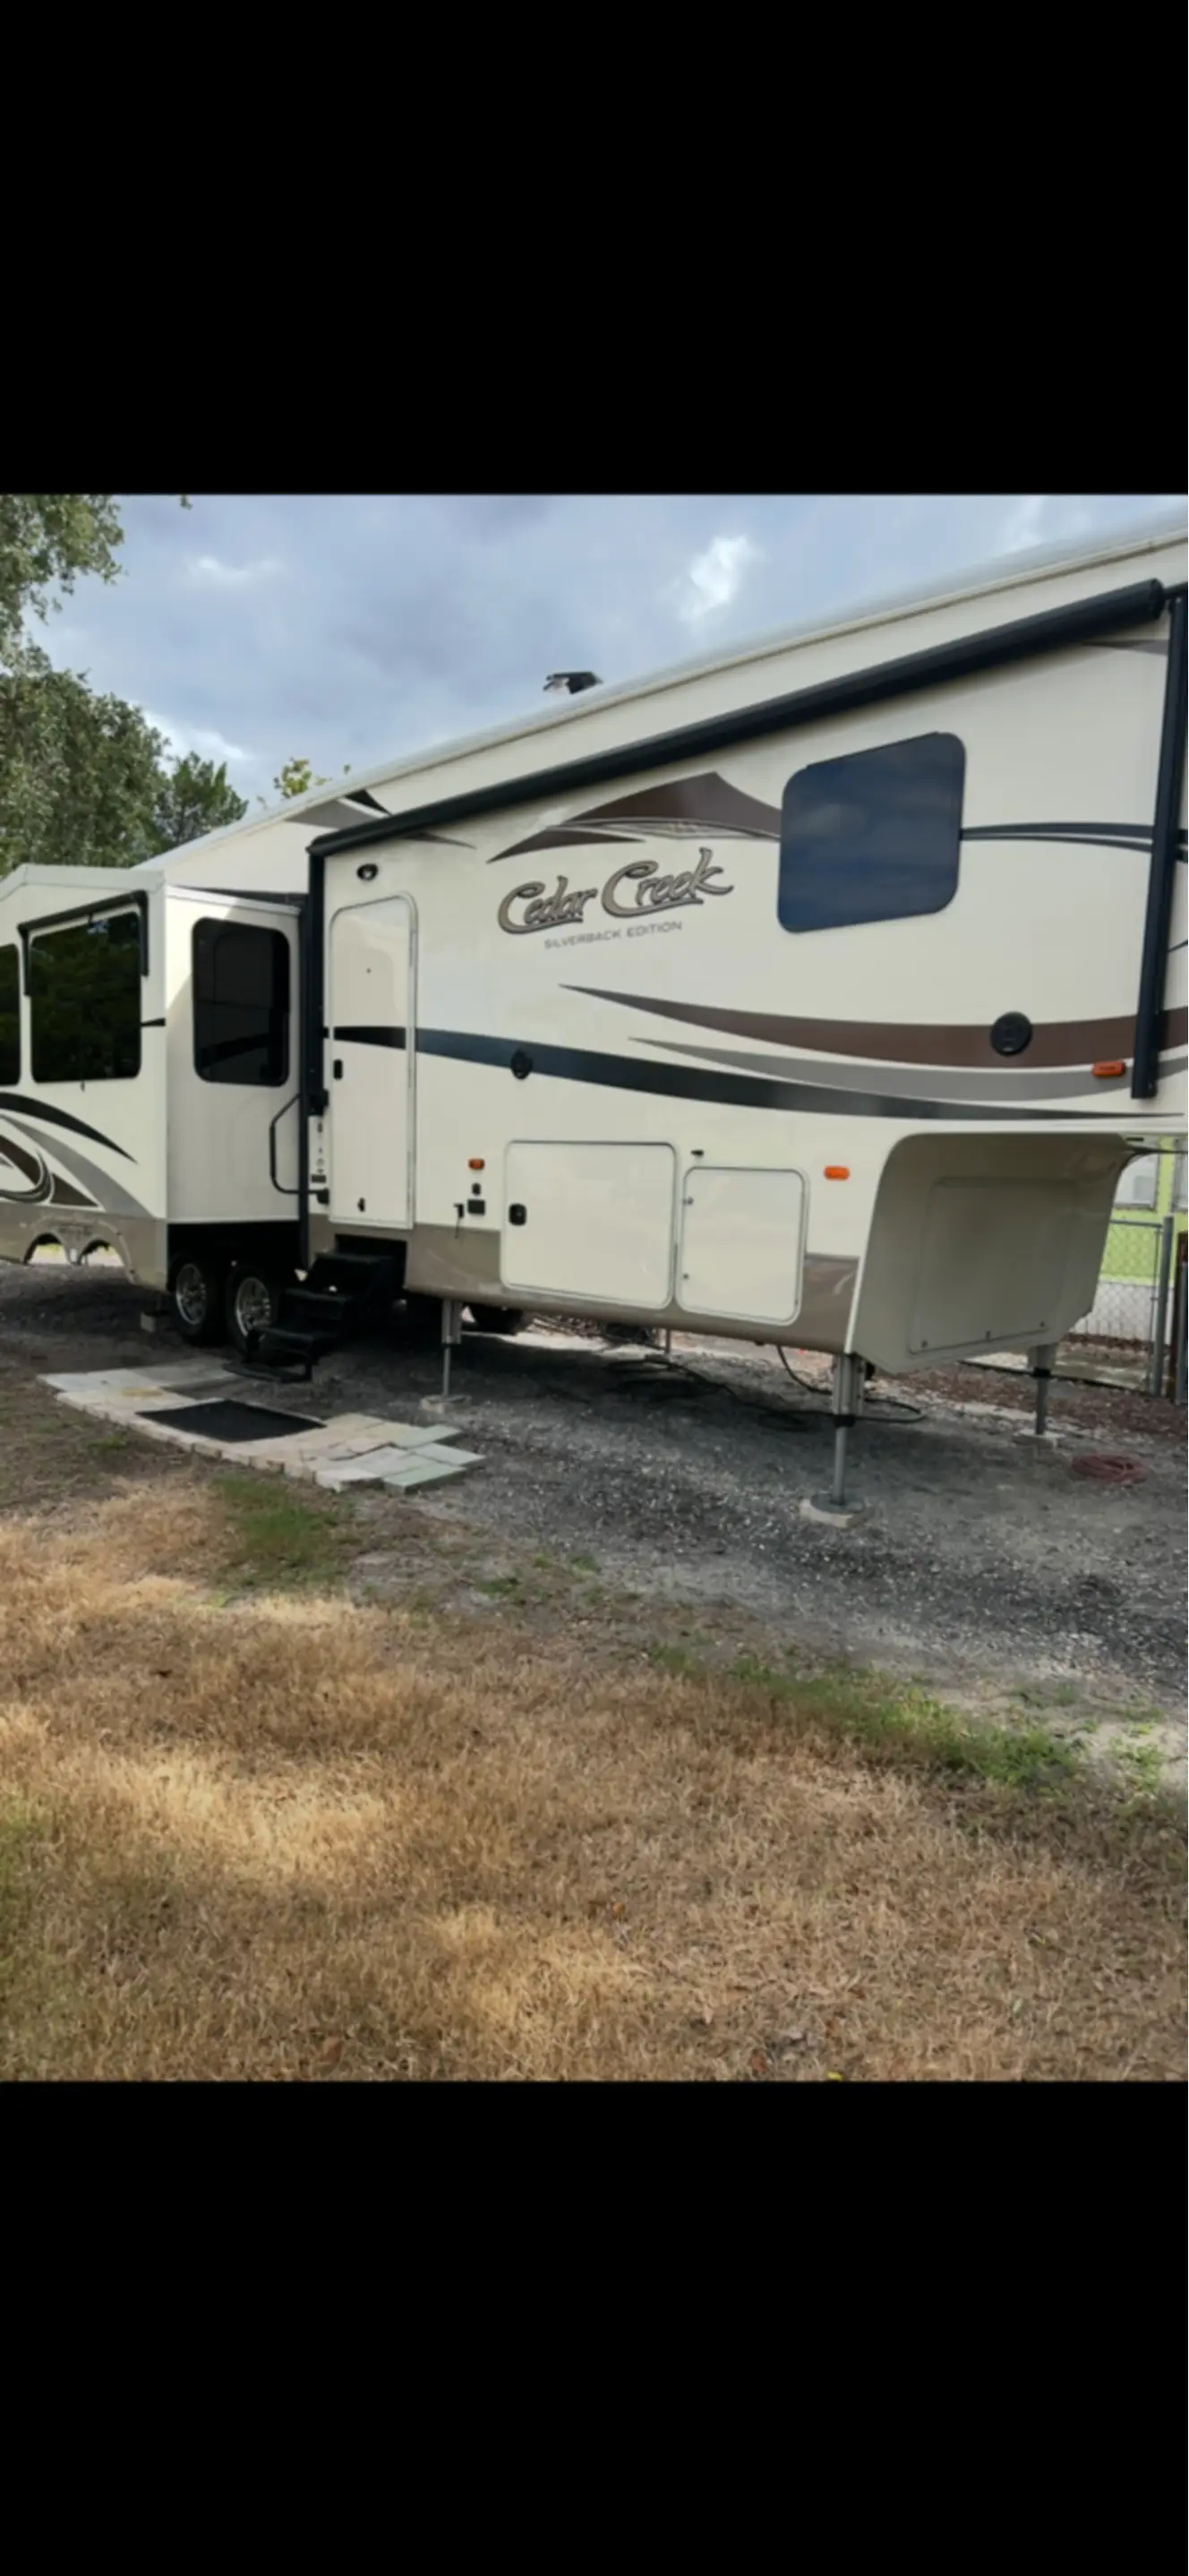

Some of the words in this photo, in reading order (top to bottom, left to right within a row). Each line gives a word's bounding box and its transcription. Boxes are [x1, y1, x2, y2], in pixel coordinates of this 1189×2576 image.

[498, 875, 598, 934] Cedar
[602, 847, 734, 918] Creek
[543, 930, 622, 949] SILVERBACK
[627, 922, 682, 939] EDITION
